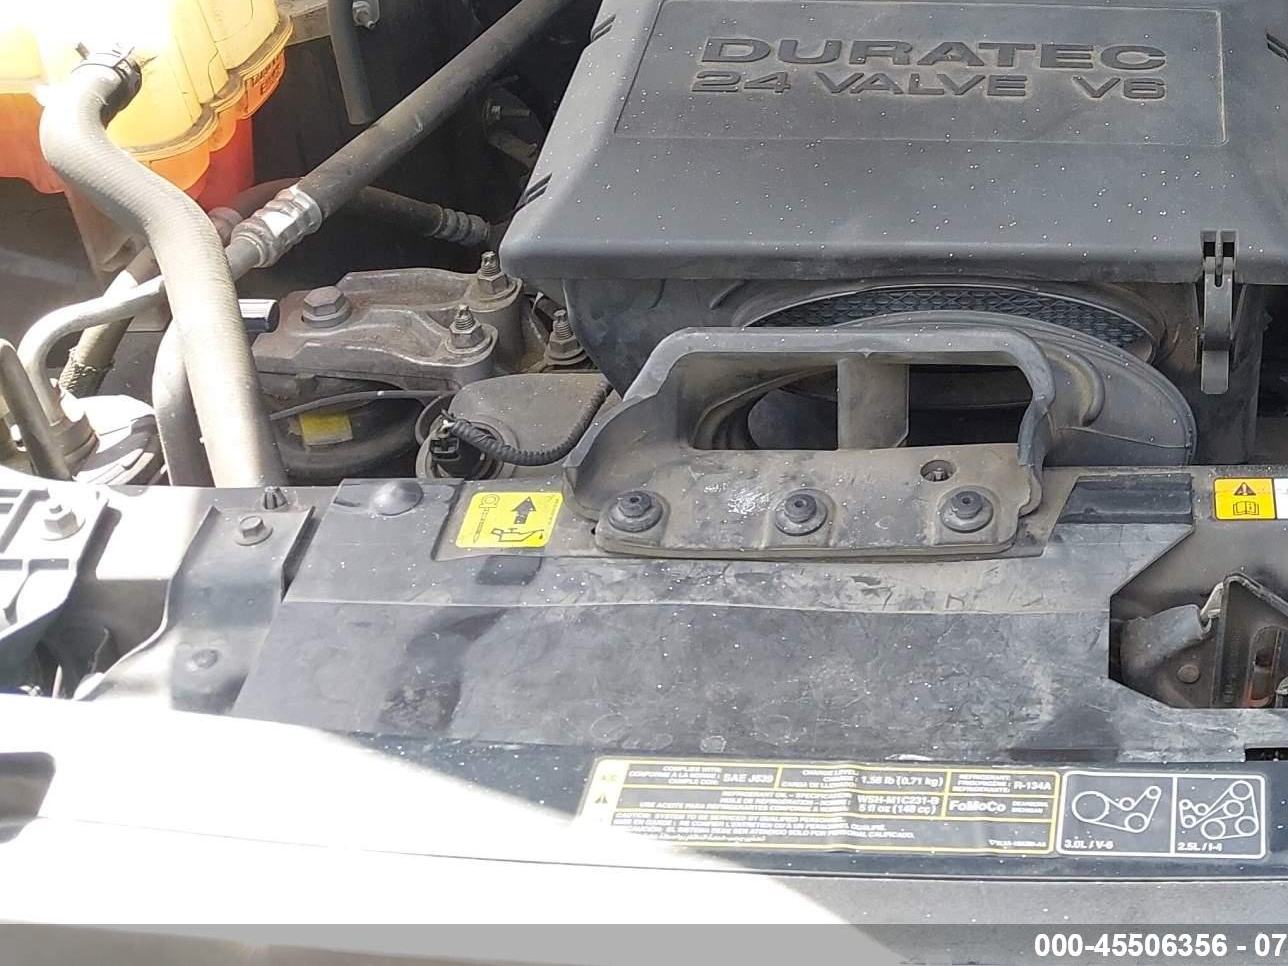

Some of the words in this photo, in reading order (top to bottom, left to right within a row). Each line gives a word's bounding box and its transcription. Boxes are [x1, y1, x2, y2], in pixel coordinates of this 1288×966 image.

[702, 37, 1167, 70] DURATEC
[692, 70, 791, 95] 24
[814, 71, 1028, 97] VALVE
[1072, 75, 1167, 101] V6
[723, 773, 747, 782] SAE
[884, 776, 895, 784] lb
[925, 777, 944, 787] kg)
[1013, 780, 1052, 791] R-134A
[859, 803, 866, 812] 5
[877, 805, 891, 813] oz
[917, 805, 937, 815] cc)
[949, 800, 1006, 812] FoMoCo
[1064, 839, 1088, 850] 3.0L
[1095, 840, 1114, 850] V-6
[1177, 842, 1201, 852] 2.5L
